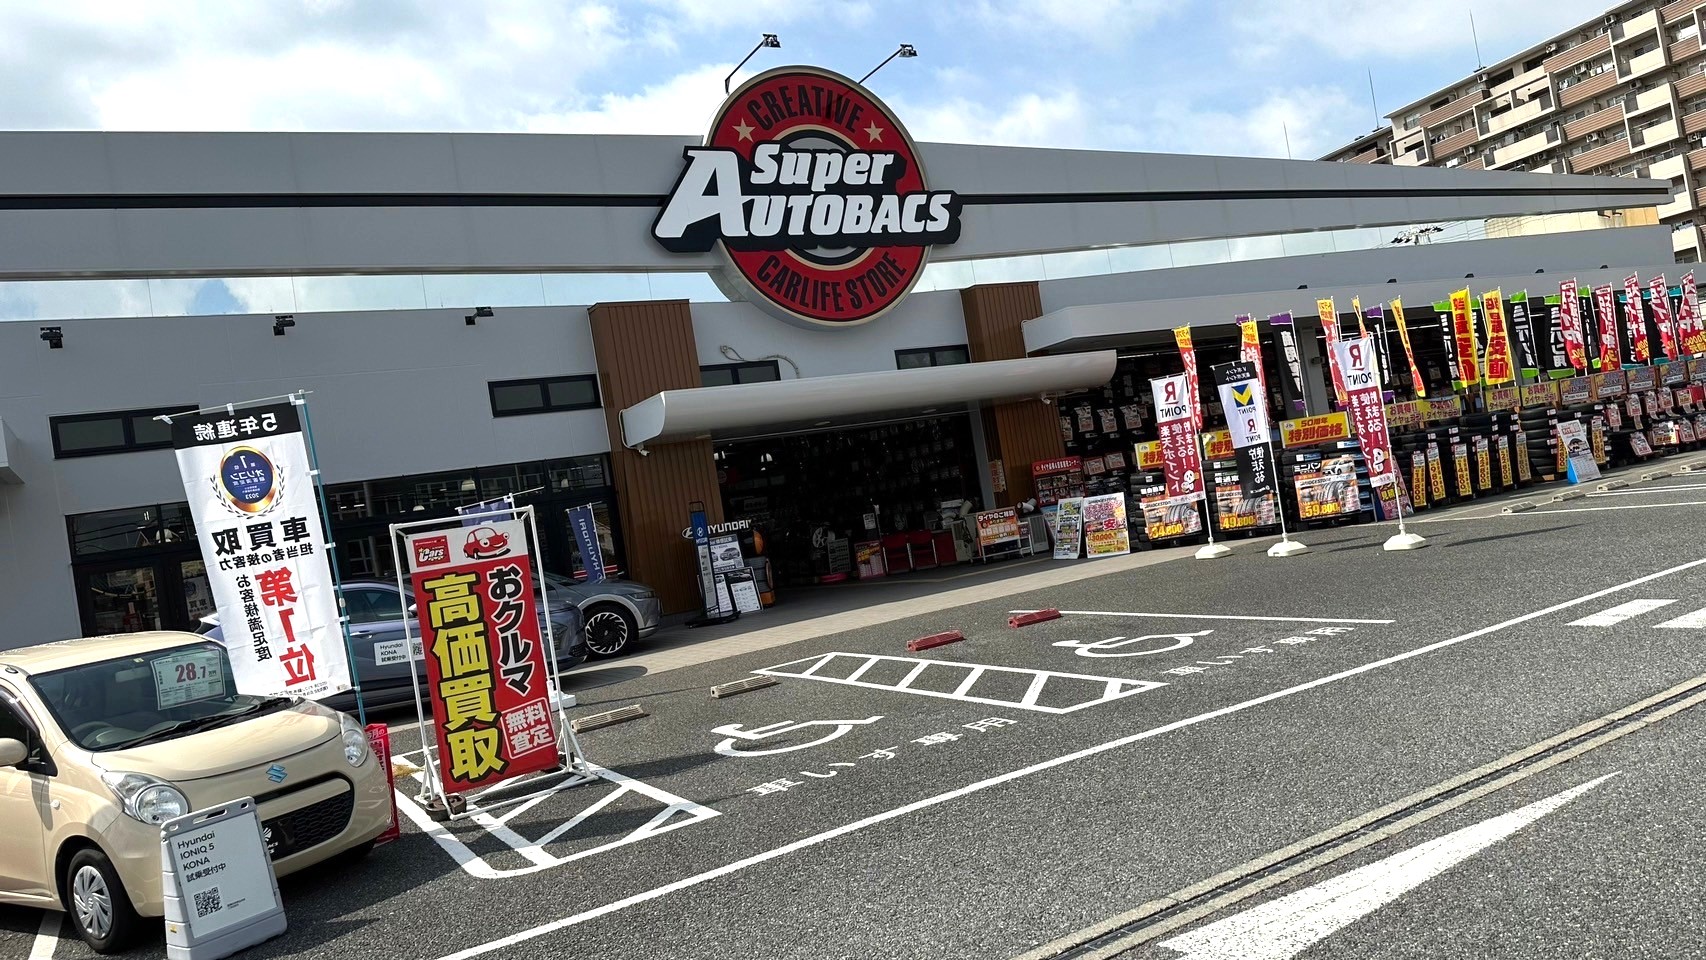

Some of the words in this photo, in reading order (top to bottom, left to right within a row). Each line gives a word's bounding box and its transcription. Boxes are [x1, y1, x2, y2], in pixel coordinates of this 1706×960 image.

[746, 84, 865, 133] CREATIVE
[750, 143, 895, 192] Super
[654, 150, 952, 238] AUTOBACS
[756, 254, 844, 312] CARLIFE
[845, 251, 907, 310] STORE
[1288, 422, 1343, 443] 特別価格
[1300, 417, 1328, 428] 50周年
[1293, 462, 1321, 473] ミニバン
[487, 565, 534, 695] おクルマ
[423, 572, 505, 780] 高価買取
[504, 701, 547, 734] 無料
[510, 726, 554, 756] 査定
[177, 830, 216, 850] Hyundai
[180, 845, 207, 861] IONIQ
[208, 842, 215, 851] 5
[182, 856, 211, 871] KONA
